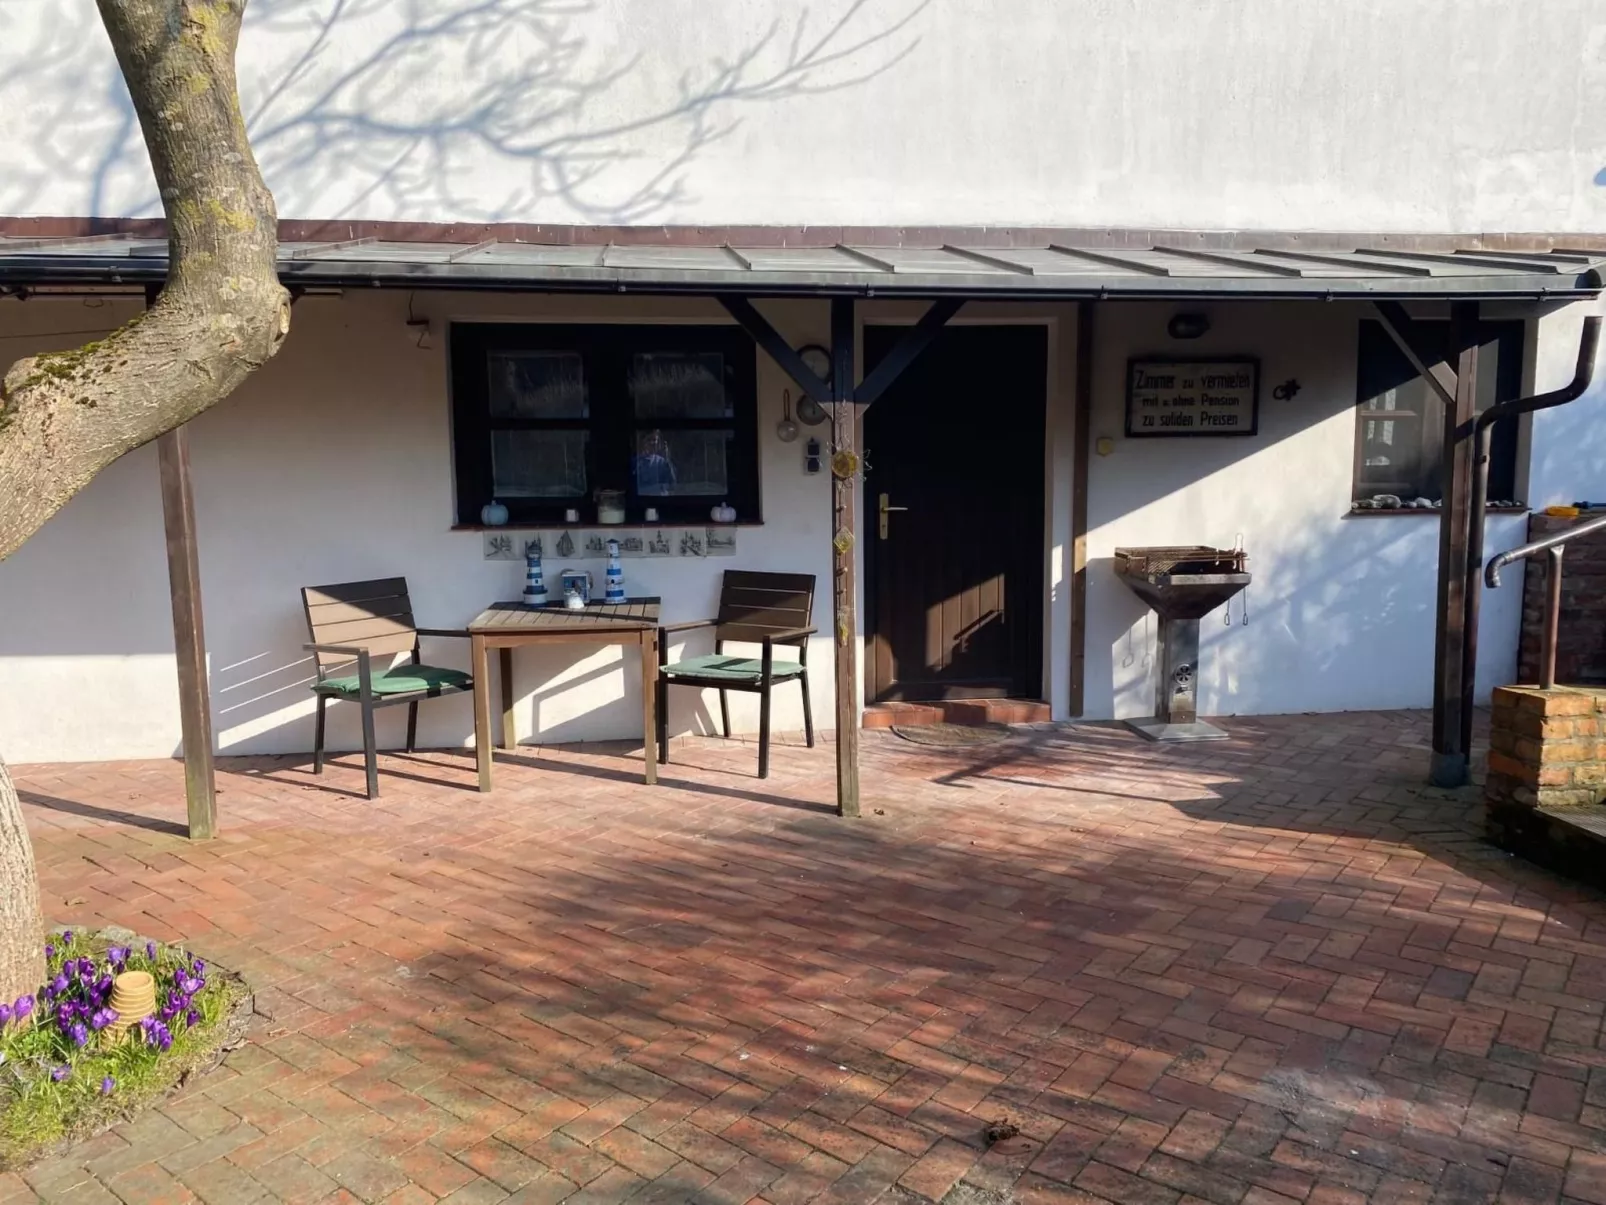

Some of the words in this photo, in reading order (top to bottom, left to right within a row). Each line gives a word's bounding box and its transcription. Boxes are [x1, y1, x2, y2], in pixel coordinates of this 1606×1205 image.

[1135, 370, 1175, 389] Zimmer
[1182, 379, 1194, 389] zu
[1201, 372, 1250, 389] vermieten
[1142, 395, 1158, 406] mit
[1172, 394, 1195, 406] ohne
[1201, 393, 1240, 406] Pension
[1142, 415, 1155, 426] zu
[1160, 411, 1193, 426] soliden
[1200, 411, 1238, 426] Preisen
